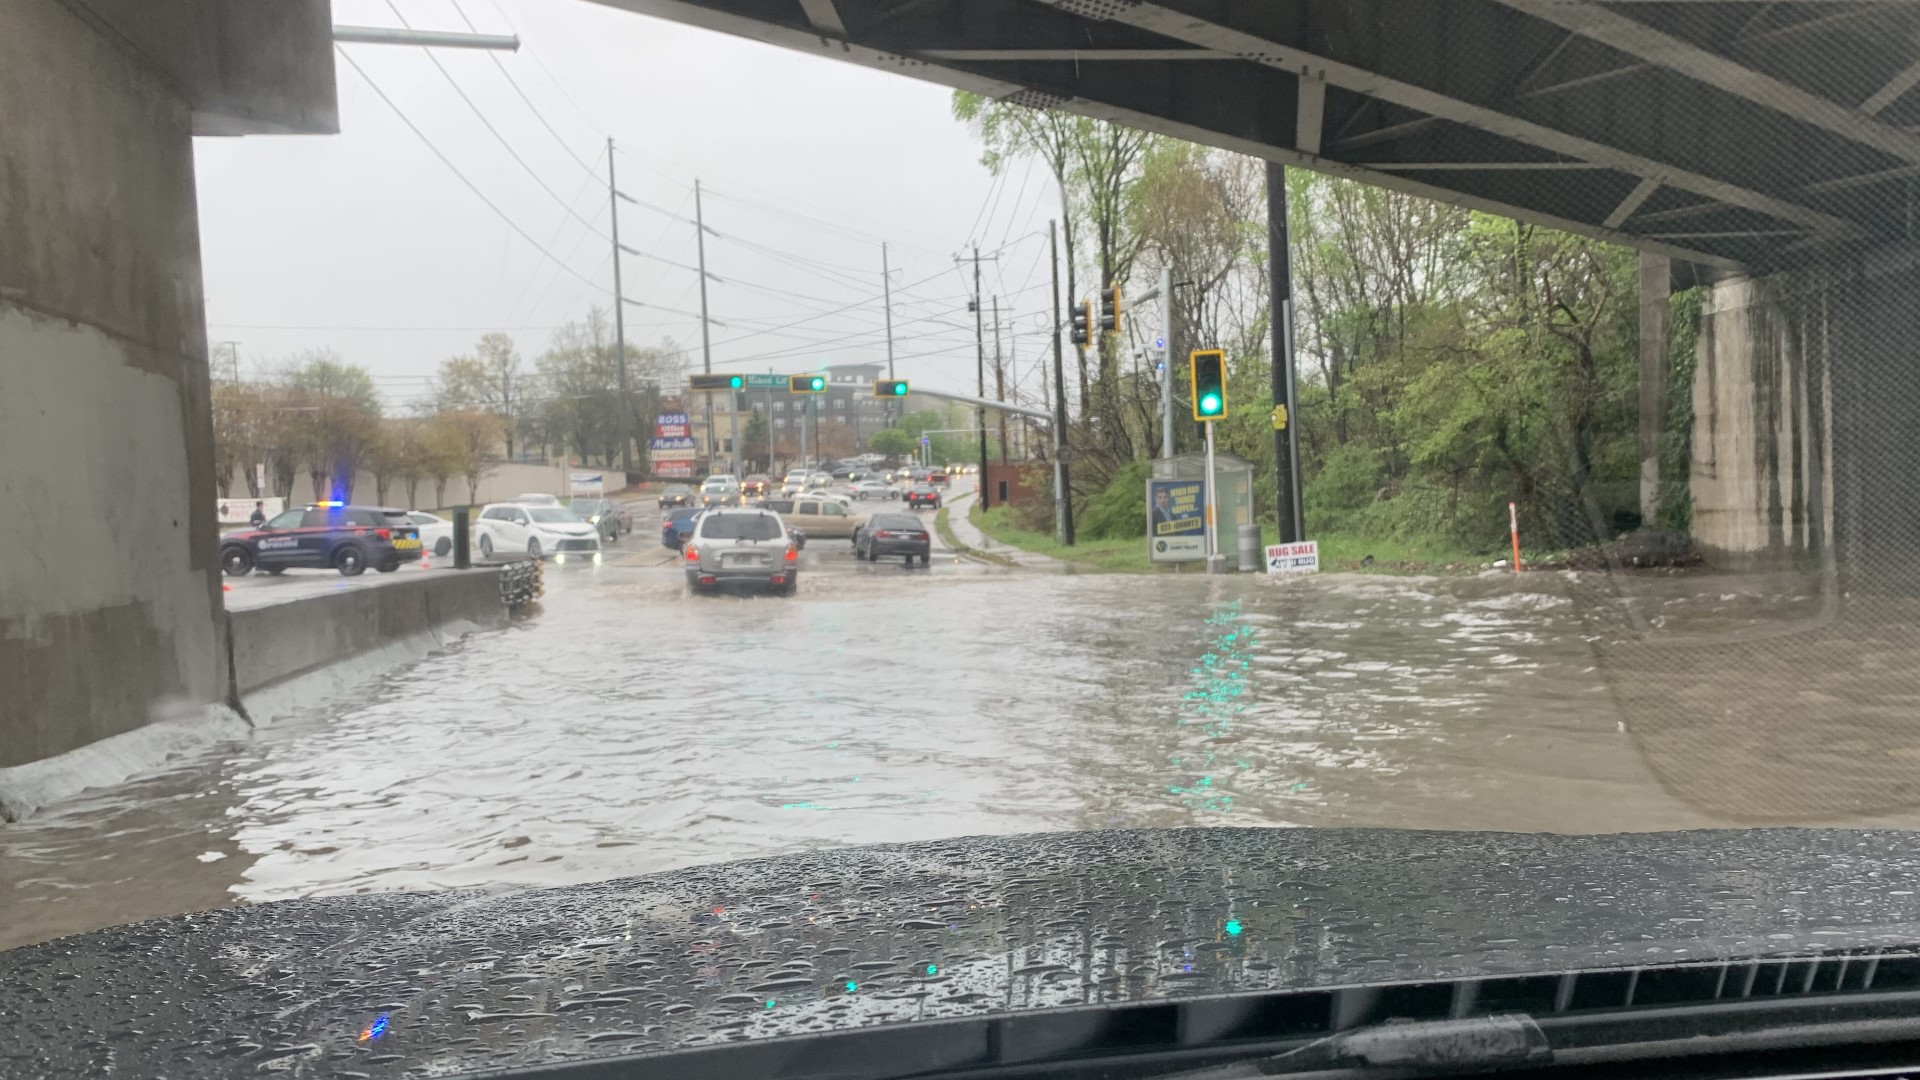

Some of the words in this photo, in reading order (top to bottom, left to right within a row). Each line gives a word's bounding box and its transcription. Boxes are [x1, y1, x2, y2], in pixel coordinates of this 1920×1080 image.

[658, 415, 686, 424] ROSS
[652, 438, 694, 448] Marshalls
[1170, 487, 1186, 496] WHEN
[1268, 546, 1289, 558] RUG
[1291, 543, 1315, 555] SALE
[1298, 557, 1315, 566] RUG
